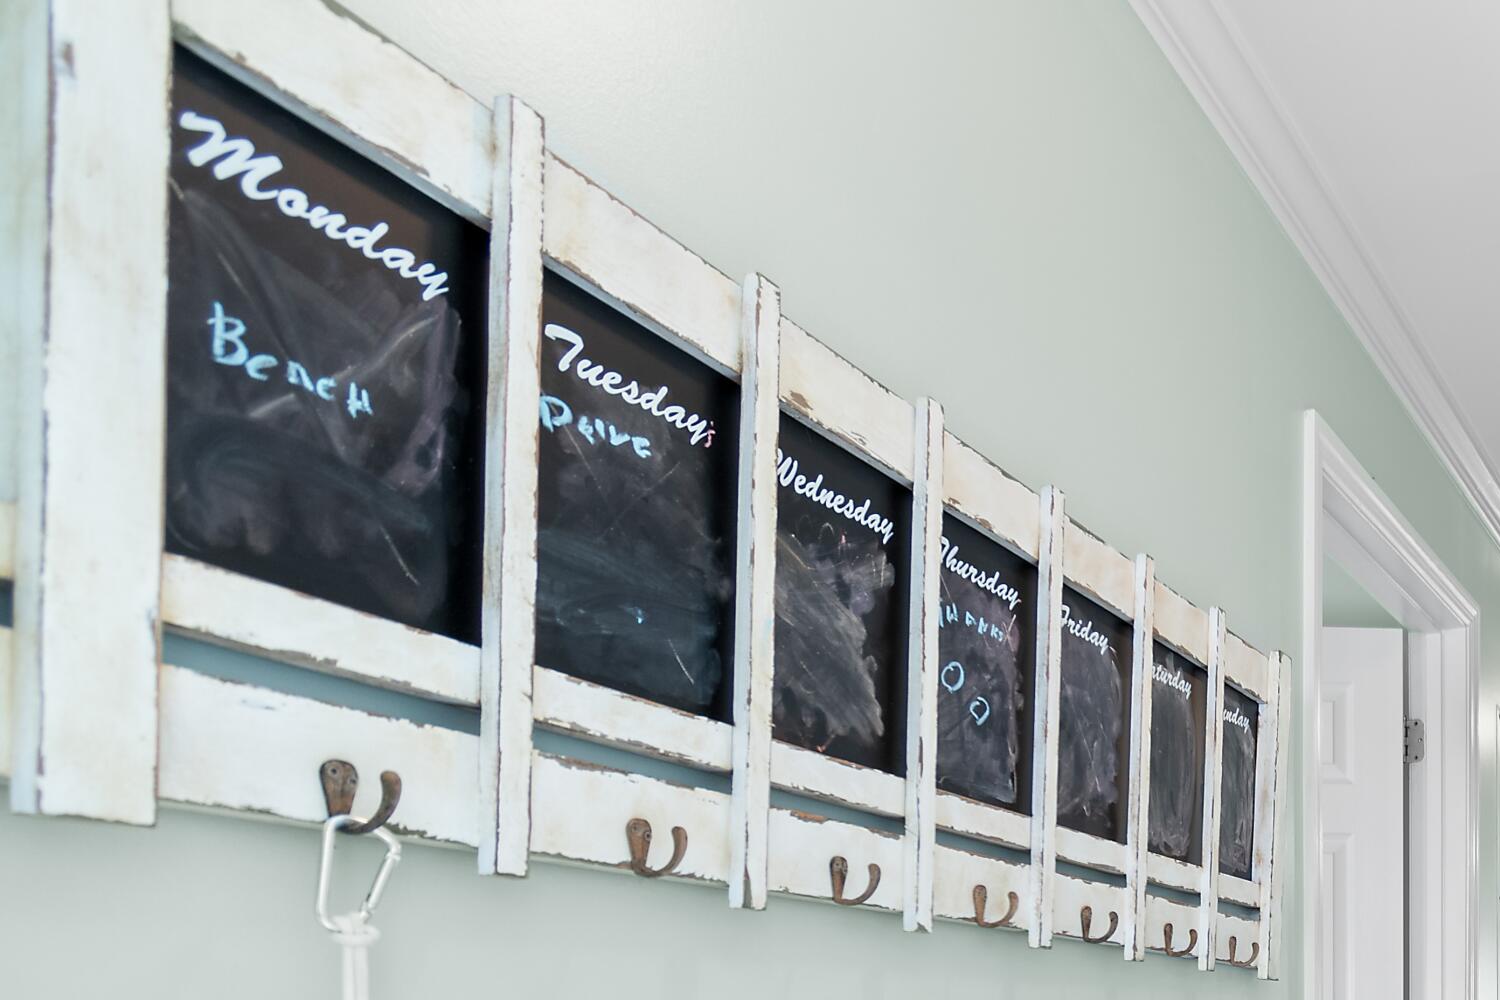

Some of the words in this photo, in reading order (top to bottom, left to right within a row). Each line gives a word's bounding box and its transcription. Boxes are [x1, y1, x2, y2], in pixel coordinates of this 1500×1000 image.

[179, 110, 449, 301] Monday
[544, 323, 708, 445] Tuesday
[777, 447, 894, 545] Wednesday
[1223, 707, 1250, 734] unday
